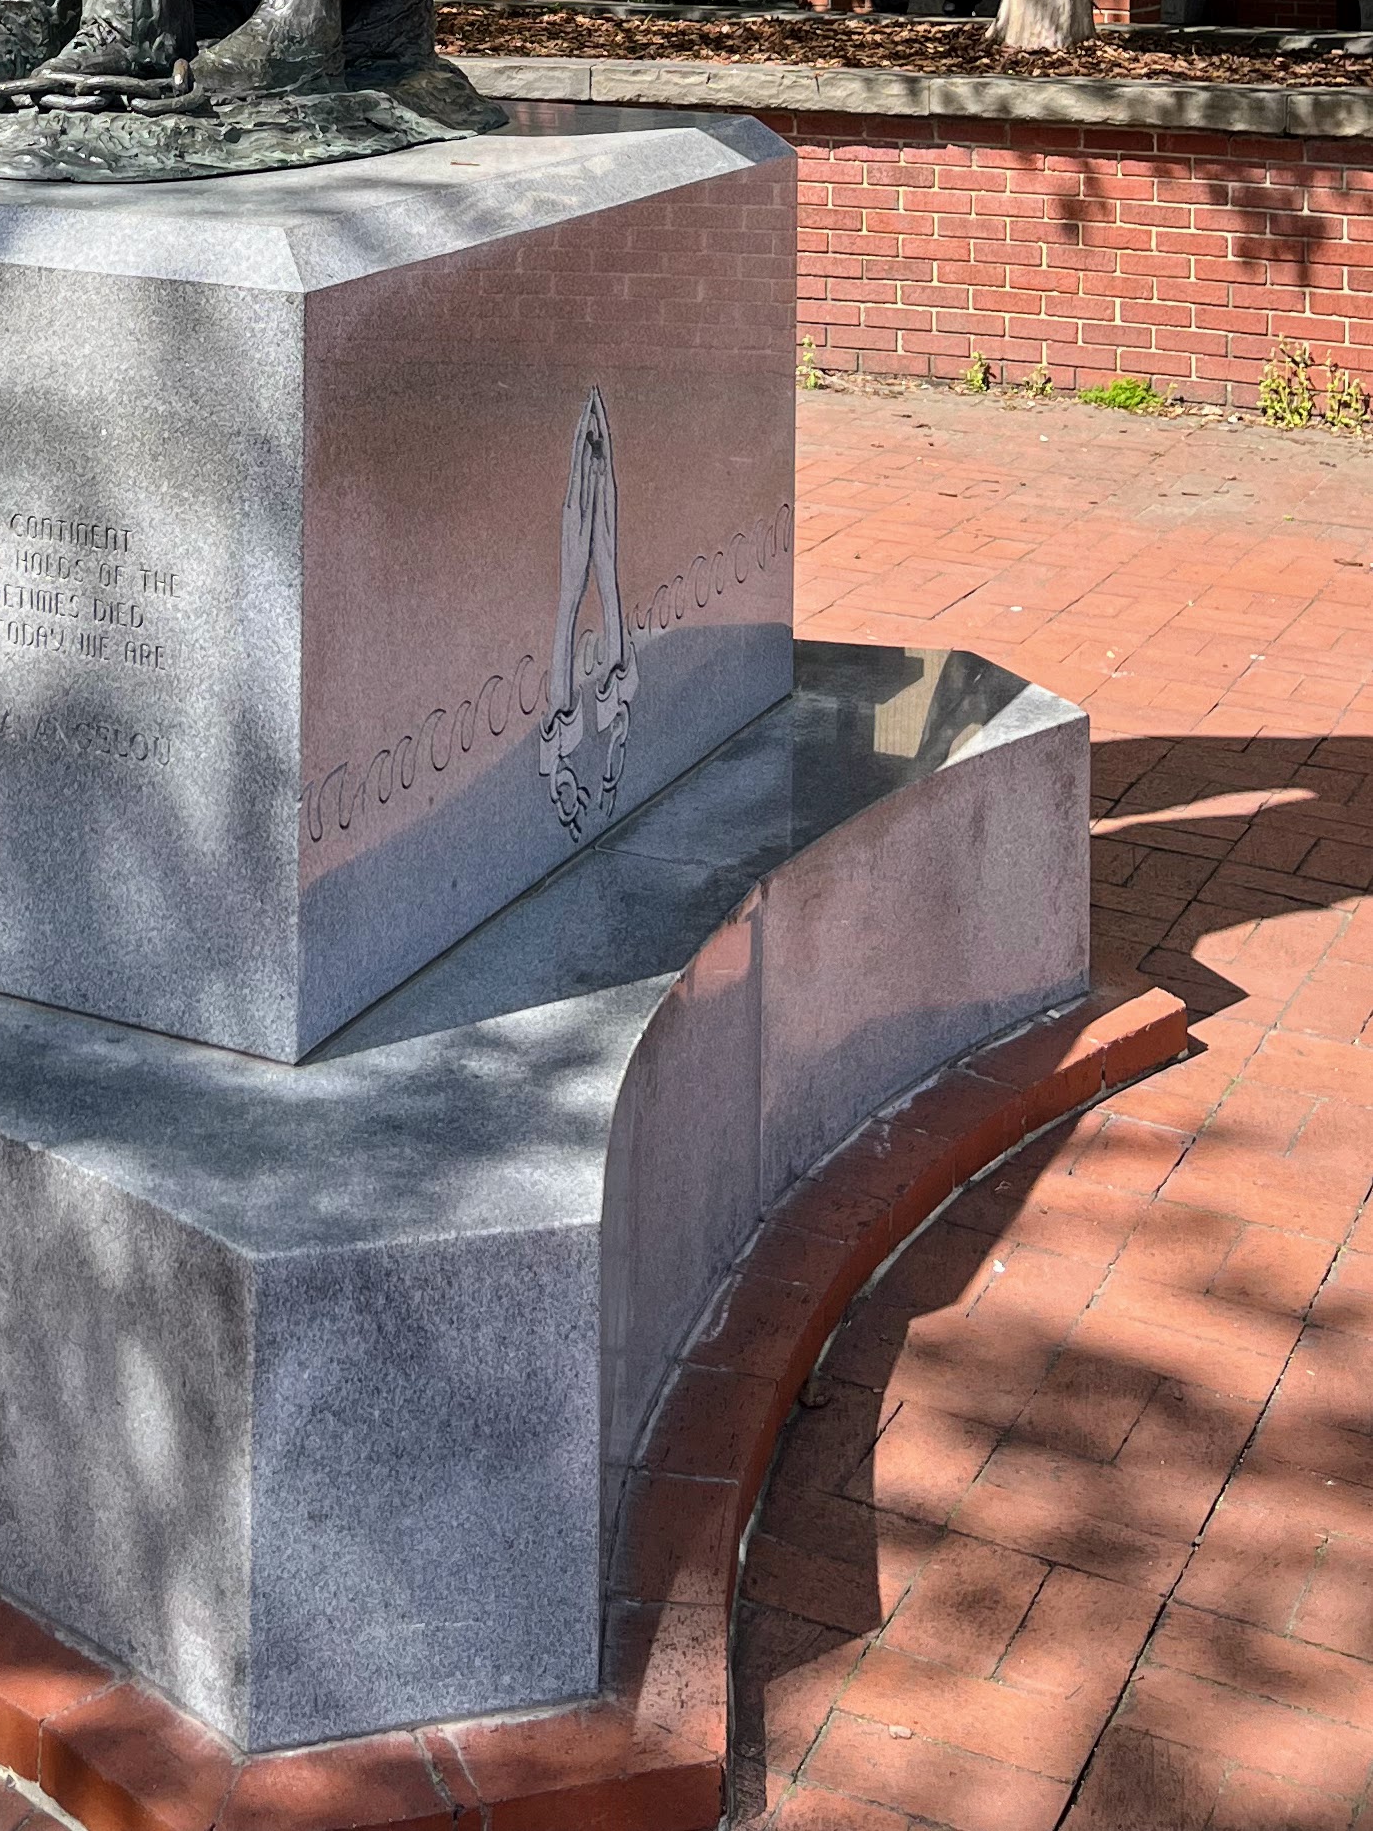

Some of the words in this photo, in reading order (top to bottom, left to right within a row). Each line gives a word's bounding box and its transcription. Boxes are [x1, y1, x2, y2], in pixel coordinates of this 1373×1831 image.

[9, 512, 132, 553] CONTINENT
[15, 549, 84, 583] HOLDS
[99, 562, 125, 589] OF
[139, 568, 181, 598] THE
[92, 597, 144, 629] DIED
[78, 632, 109, 661] WE
[123, 640, 166, 670] ARE
